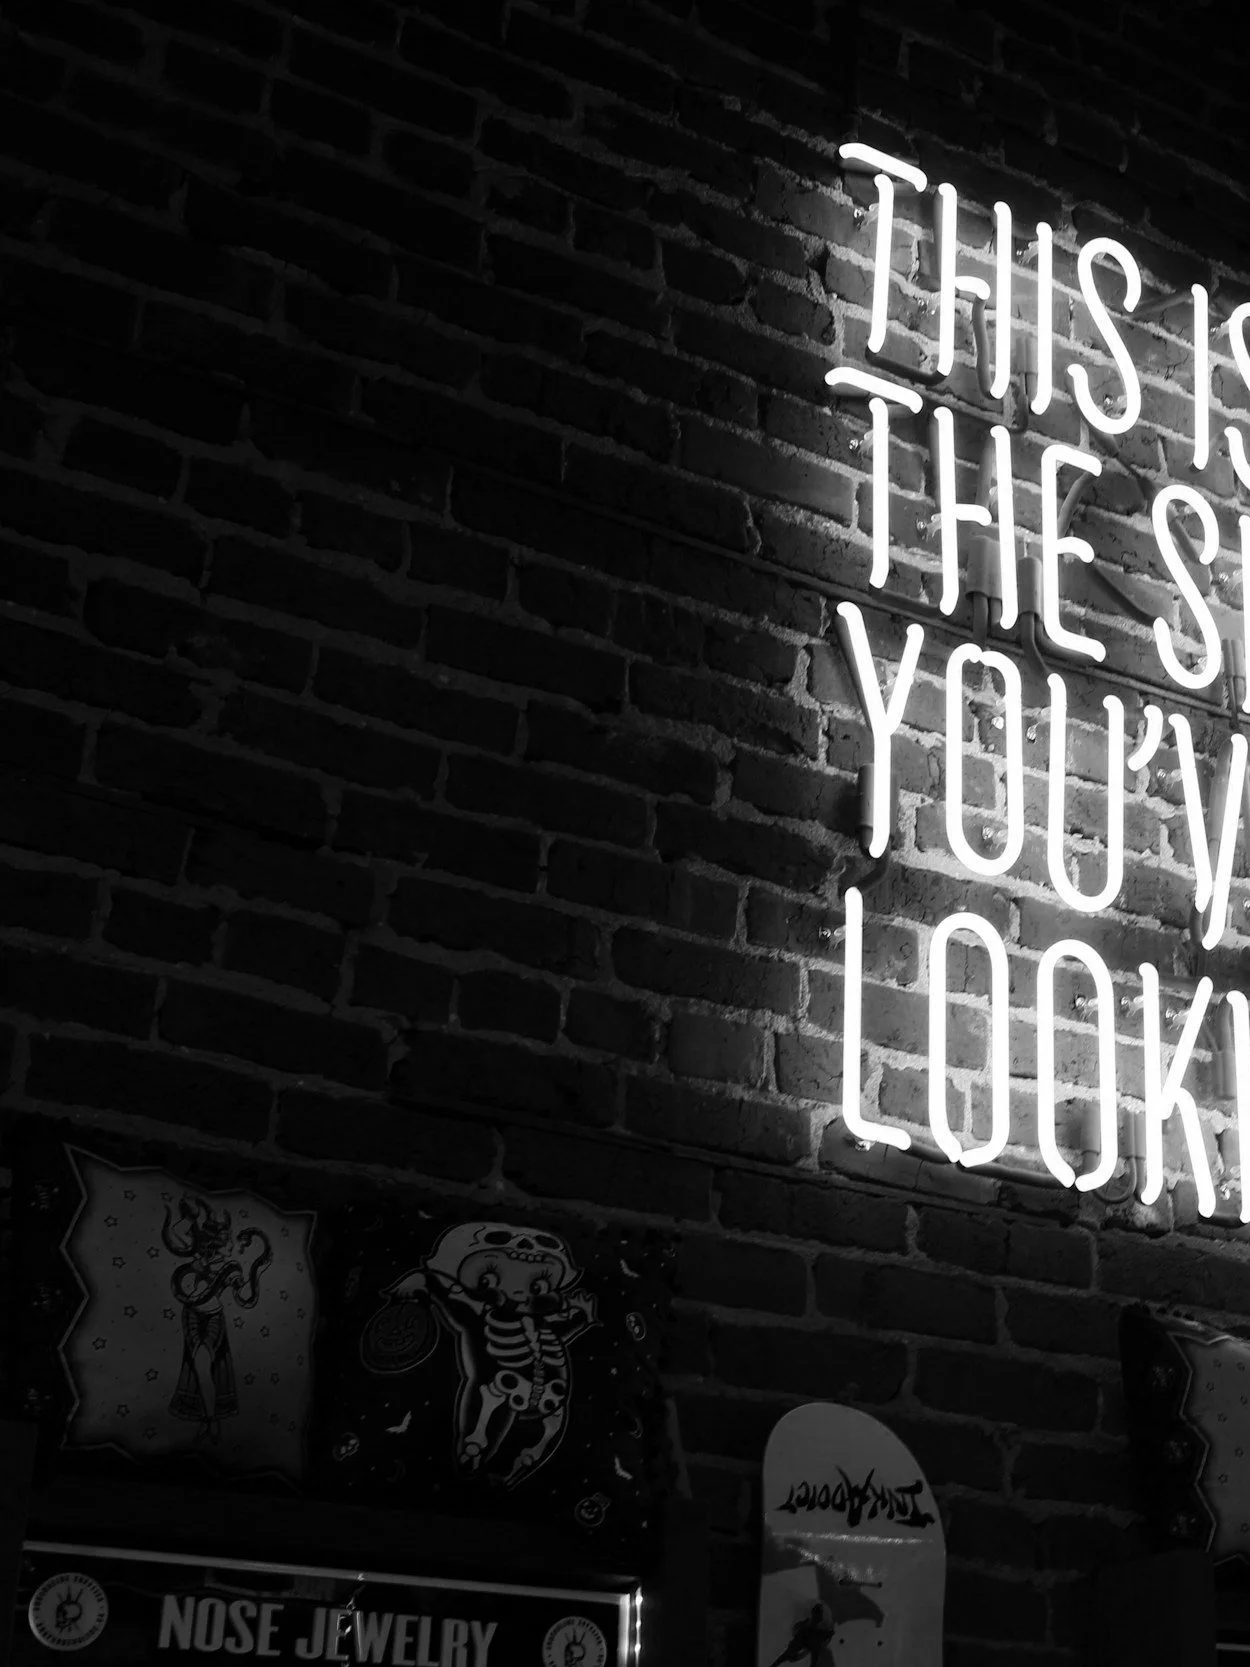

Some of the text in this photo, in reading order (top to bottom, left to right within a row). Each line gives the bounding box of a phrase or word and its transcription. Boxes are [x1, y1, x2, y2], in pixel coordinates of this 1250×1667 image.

[839, 142, 1142, 435] THIS
[825, 367, 1106, 662] THE
[156, 1594, 285, 1657] NOSE
[294, 1605, 499, 1667] JEWELRY
